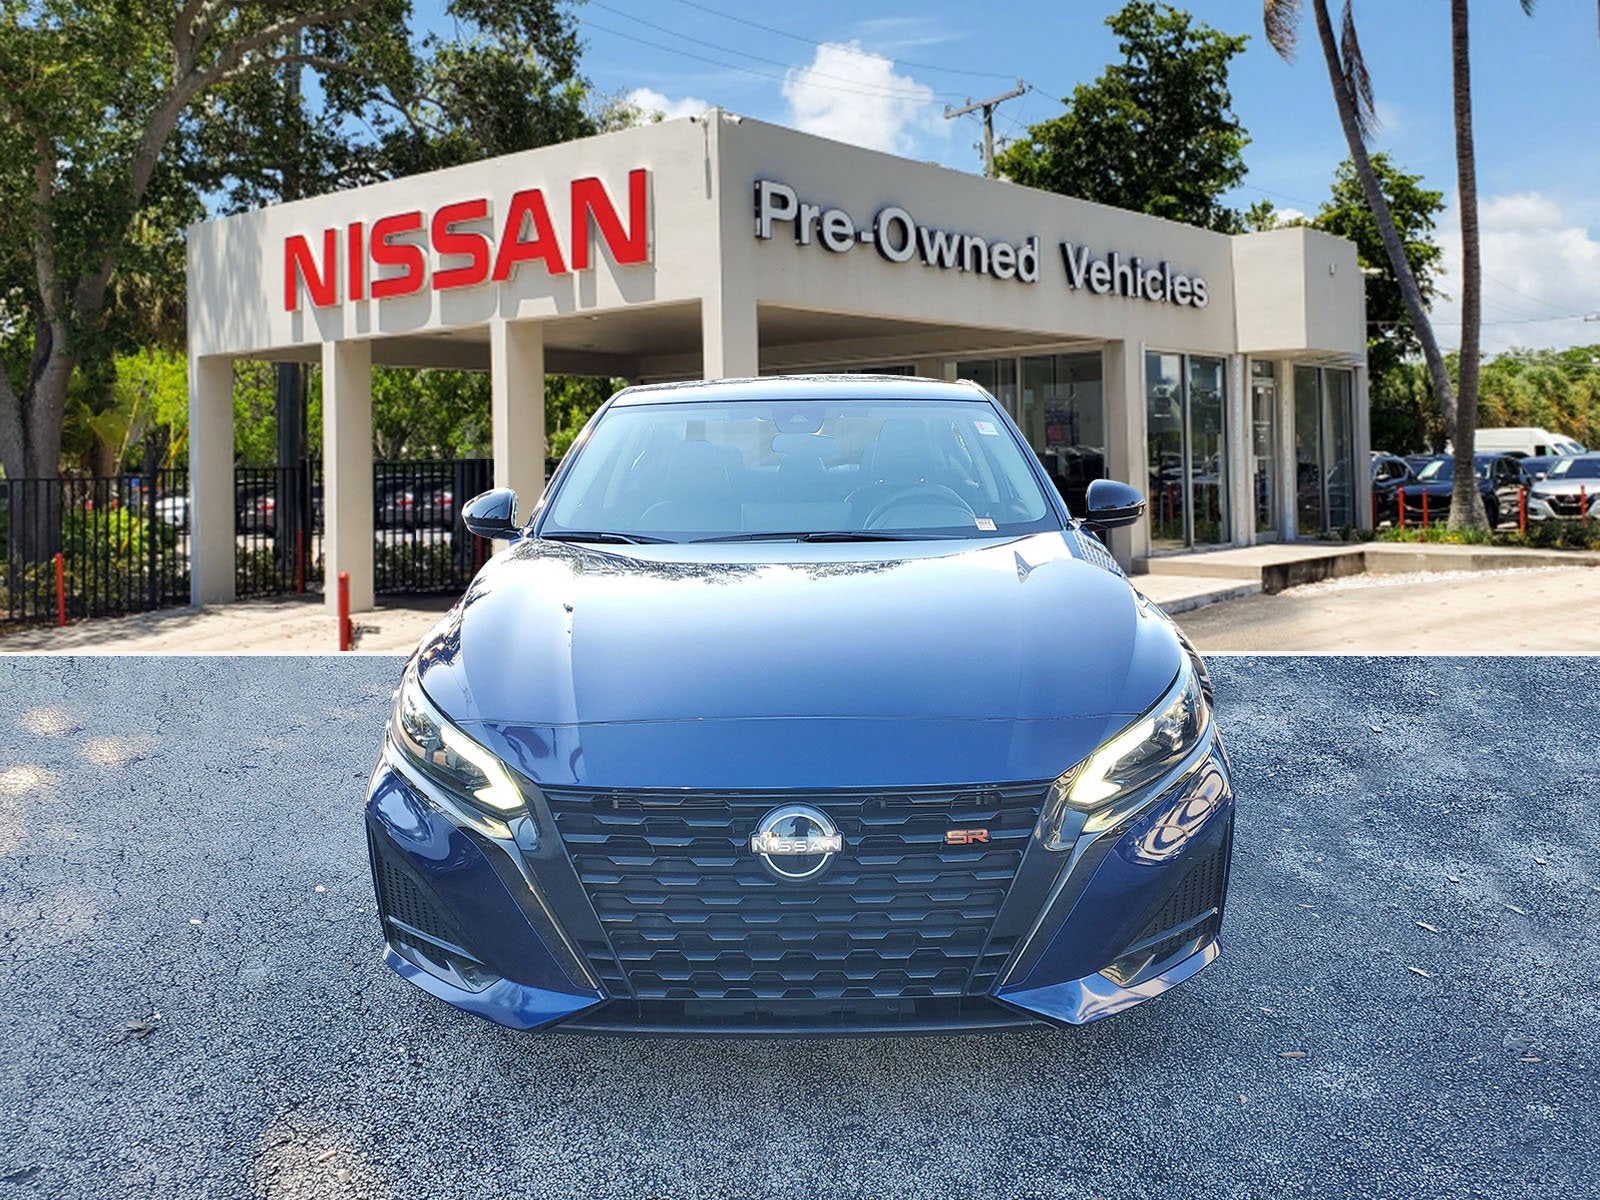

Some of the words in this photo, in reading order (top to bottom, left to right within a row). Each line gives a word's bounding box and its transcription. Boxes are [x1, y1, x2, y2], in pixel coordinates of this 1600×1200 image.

[284, 168, 648, 312] NISSAN
[754, 179, 1040, 283] Pre-Owned
[1060, 242, 1209, 309] Vehicles
[752, 837, 841, 854] NISSAN
[946, 828, 989, 845] SR
